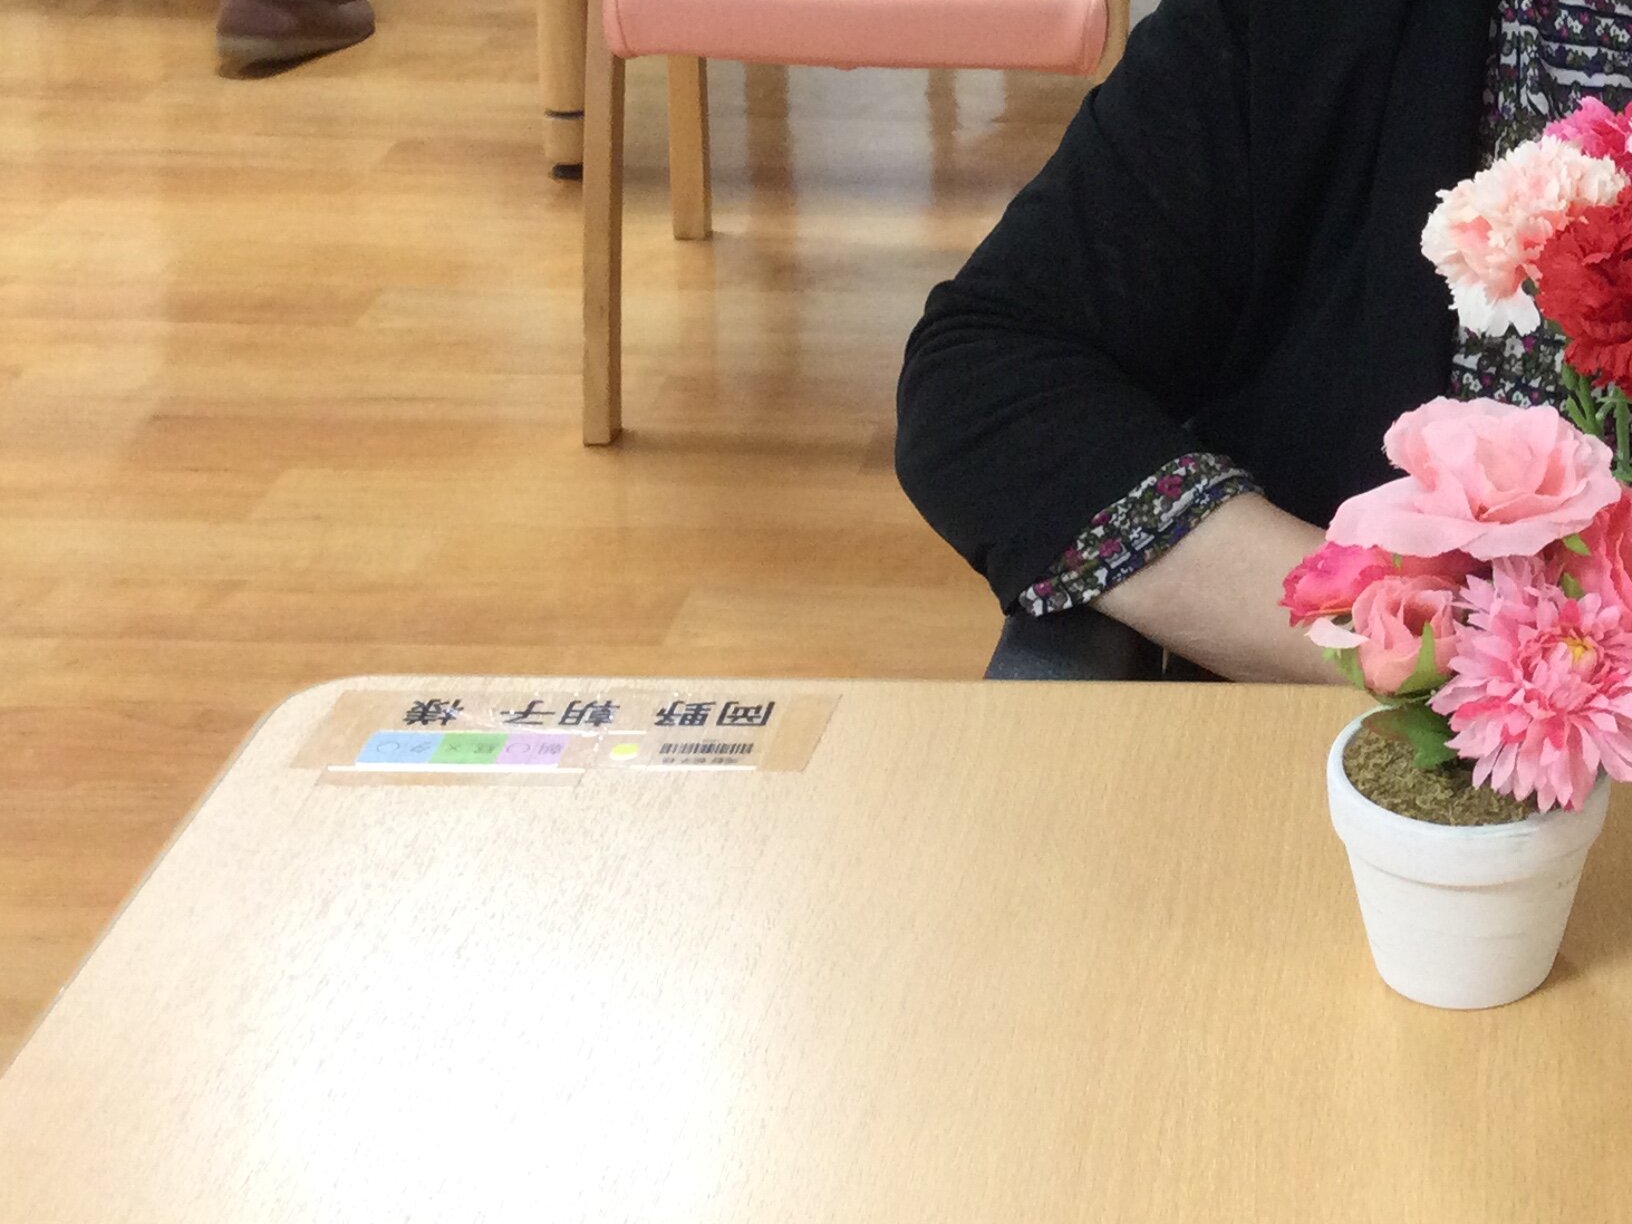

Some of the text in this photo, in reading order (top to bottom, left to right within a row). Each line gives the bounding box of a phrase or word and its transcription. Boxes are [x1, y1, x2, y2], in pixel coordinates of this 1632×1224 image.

[403, 699, 775, 727] 岡野 朝子 様
